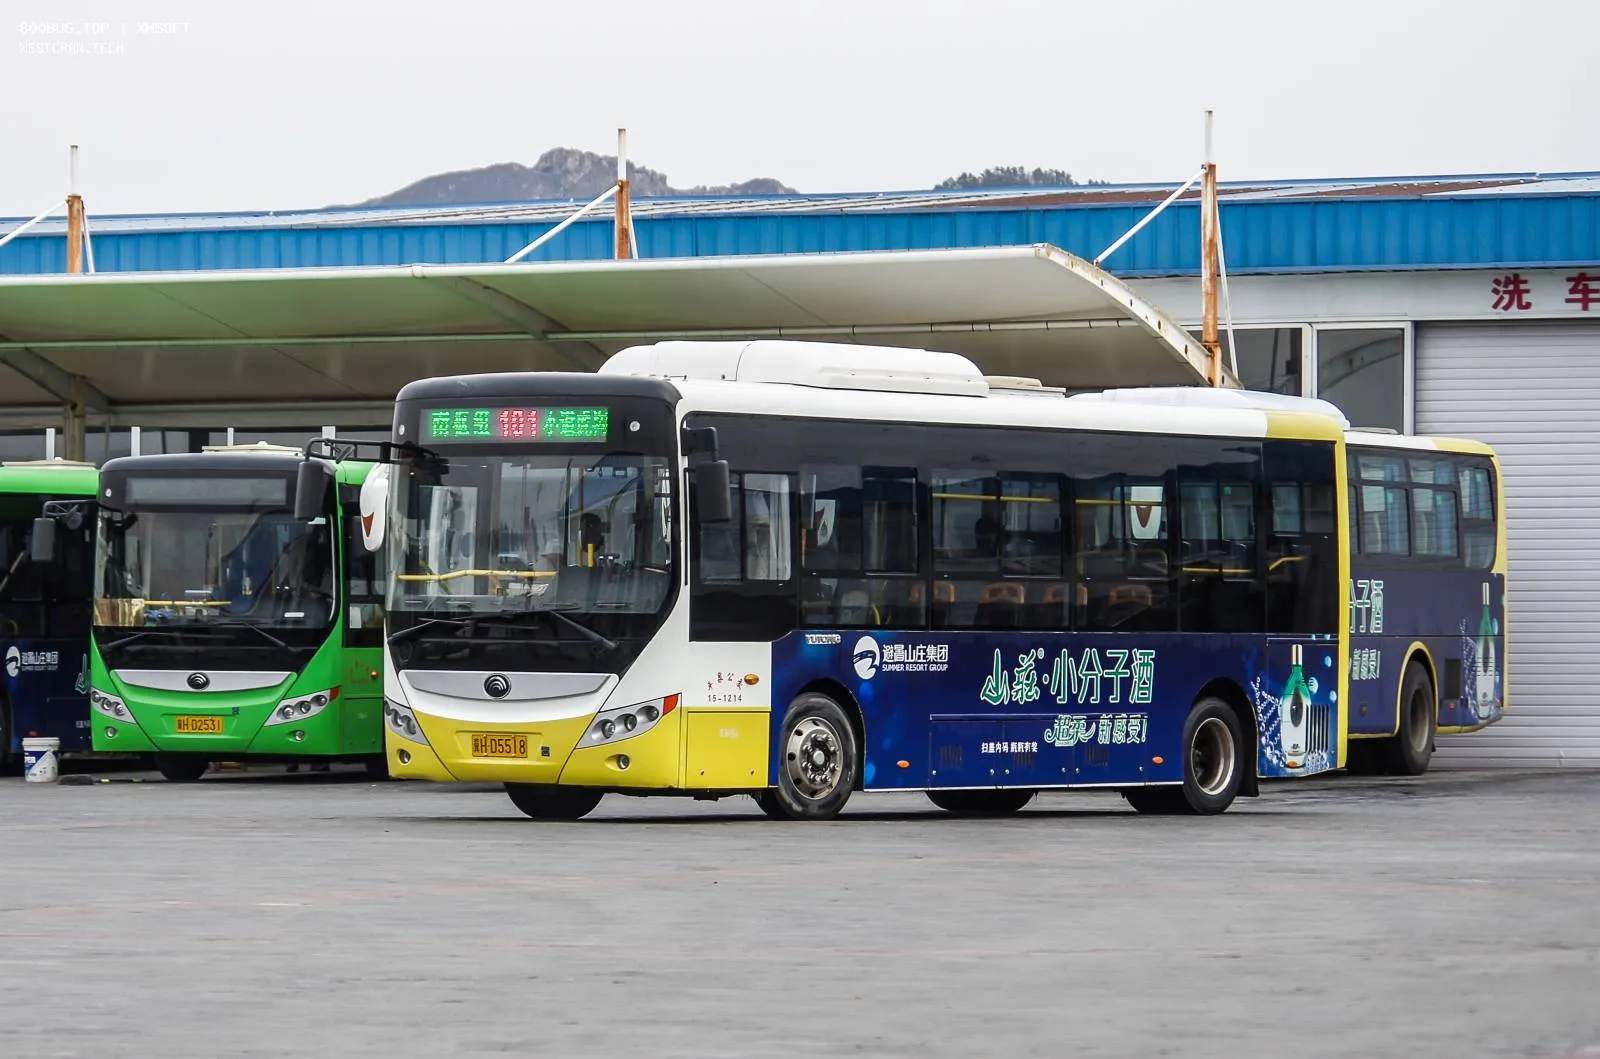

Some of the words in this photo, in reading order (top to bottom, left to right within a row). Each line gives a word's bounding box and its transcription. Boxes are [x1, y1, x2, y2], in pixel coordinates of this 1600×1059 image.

[500, 410, 536, 436] 101
[882, 644, 949, 662] 避暑山庄集团
[882, 663, 904, 672] SUMMER
[906, 663, 928, 671] RESORT
[929, 663, 949, 672] GROUP
[708, 693, 742, 703] 15-1214
